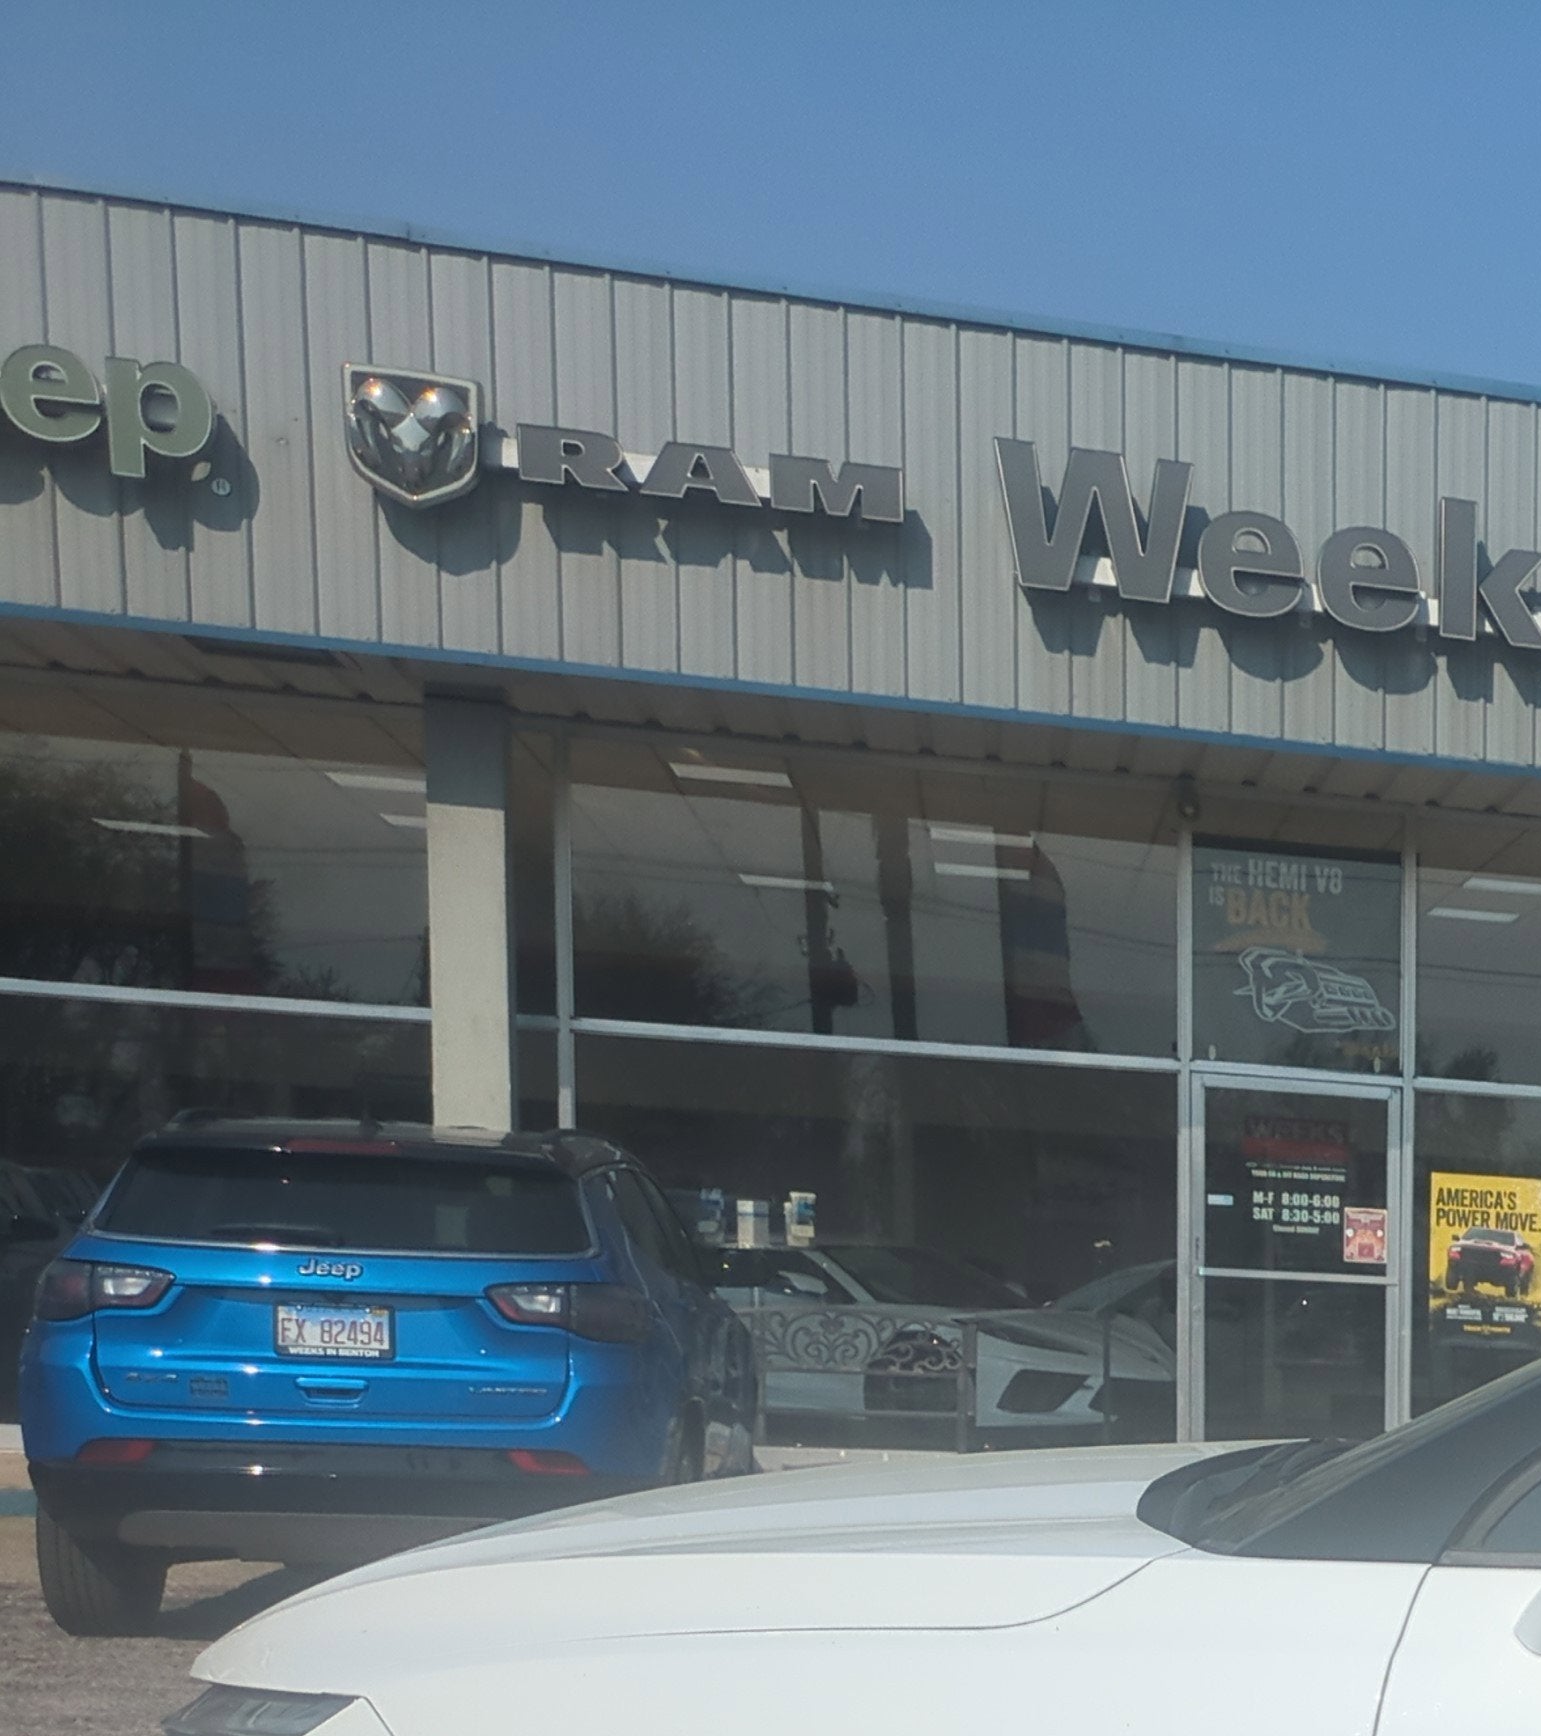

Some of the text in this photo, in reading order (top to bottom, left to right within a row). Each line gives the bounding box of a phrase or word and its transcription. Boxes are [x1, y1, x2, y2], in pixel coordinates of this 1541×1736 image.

[517, 423, 904, 522] RAM
[1210, 858, 1343, 895] THE HEMI V8
[1208, 885, 1312, 930] IS BACK
[1252, 1190, 1340, 1208] M-F 8:00-6:00
[1435, 1187, 1517, 1210] AMERICA'S
[1252, 1206, 1340, 1224] SAT 8:30-5:00
[1436, 1208, 1541, 1233] POWER MOVE.
[297, 1258, 363, 1281] Jeep
[281, 1317, 384, 1346] FX 82494
